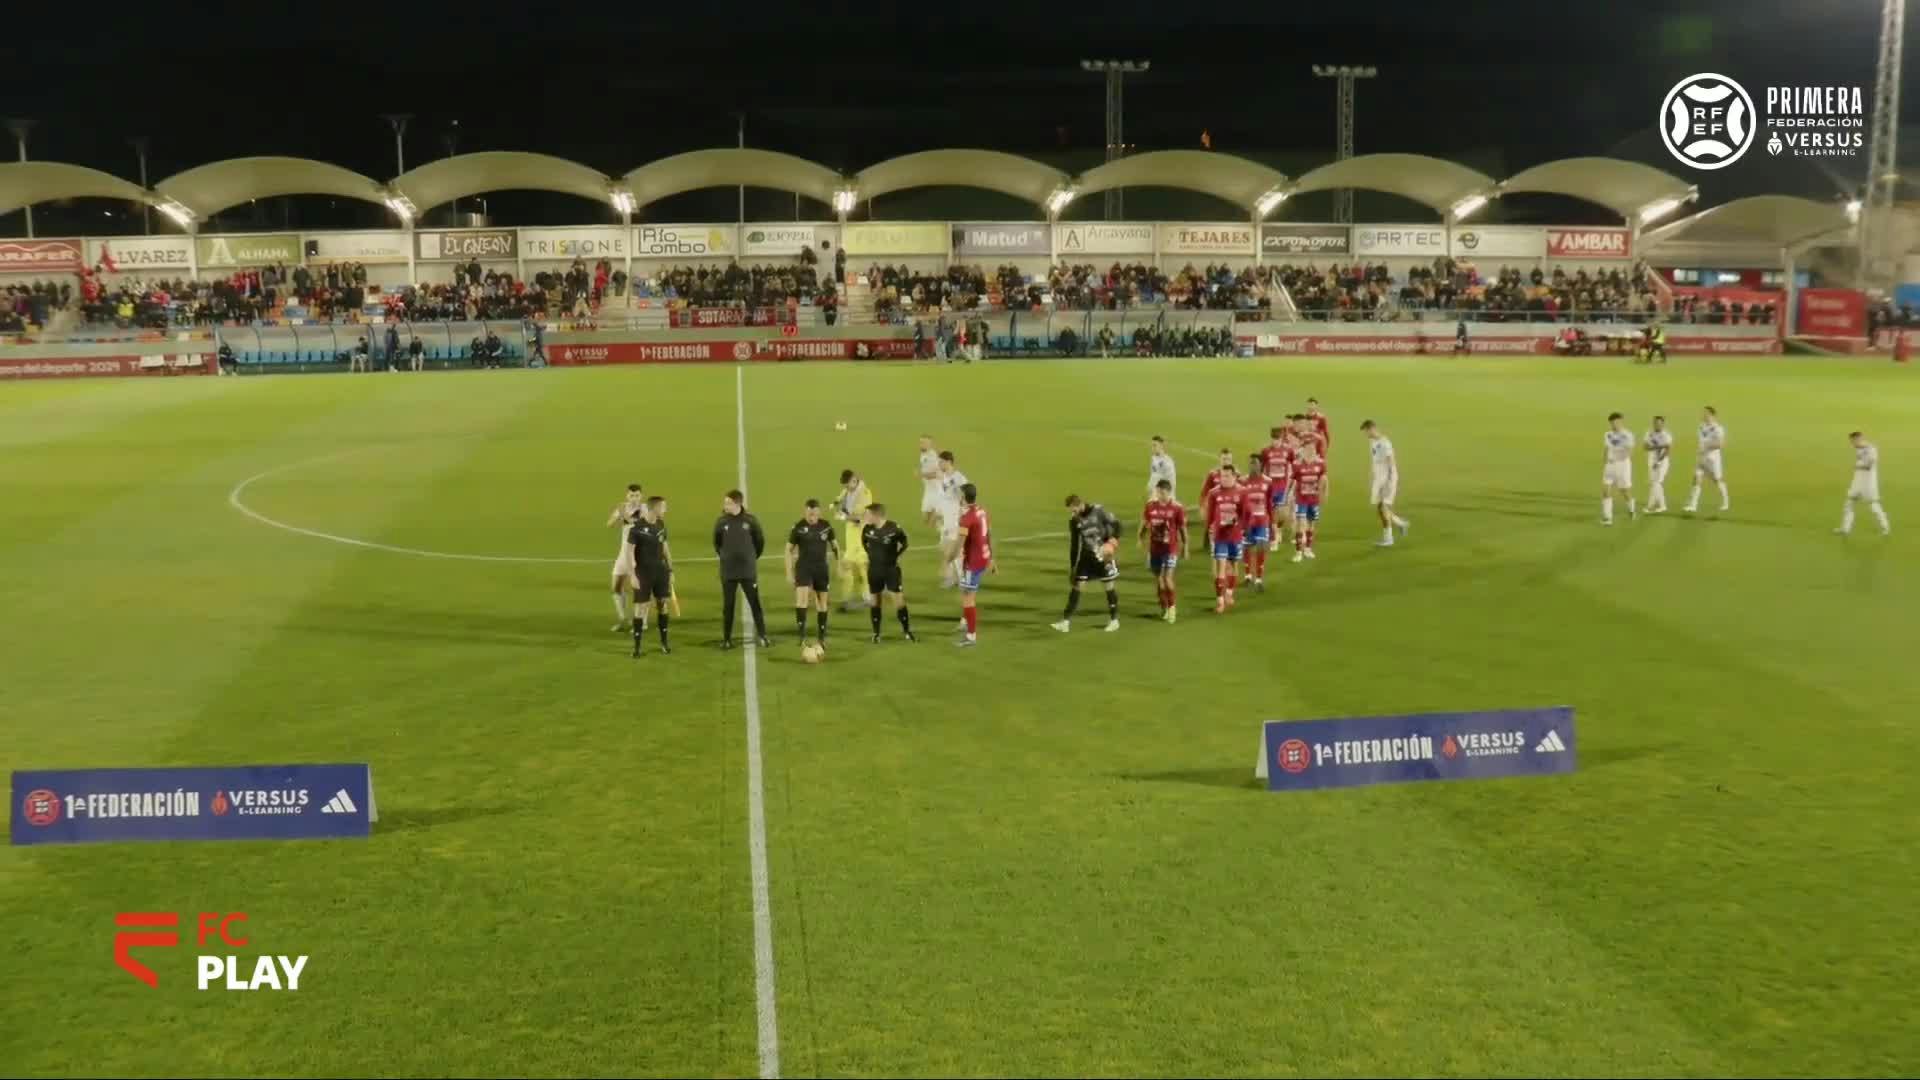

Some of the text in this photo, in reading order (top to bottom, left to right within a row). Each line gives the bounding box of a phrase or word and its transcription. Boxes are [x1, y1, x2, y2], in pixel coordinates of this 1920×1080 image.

[972, 231, 1028, 247] Matud
[1179, 231, 1250, 244] TEJARES
[1561, 233, 1625, 250] AMBAR
[239, 248, 289, 259] ALHAMA
[527, 239, 624, 254] TRISTONE
[652, 344, 710, 360] FEDERACIÓN
[1457, 731, 1525, 748] VERSUS
[1334, 734, 1433, 763] FEDERACIÓN
[88, 788, 200, 818] FEDERACIÓN
[229, 789, 309, 806] VERSUS
[238, 806, 303, 815] E-LEARNING
